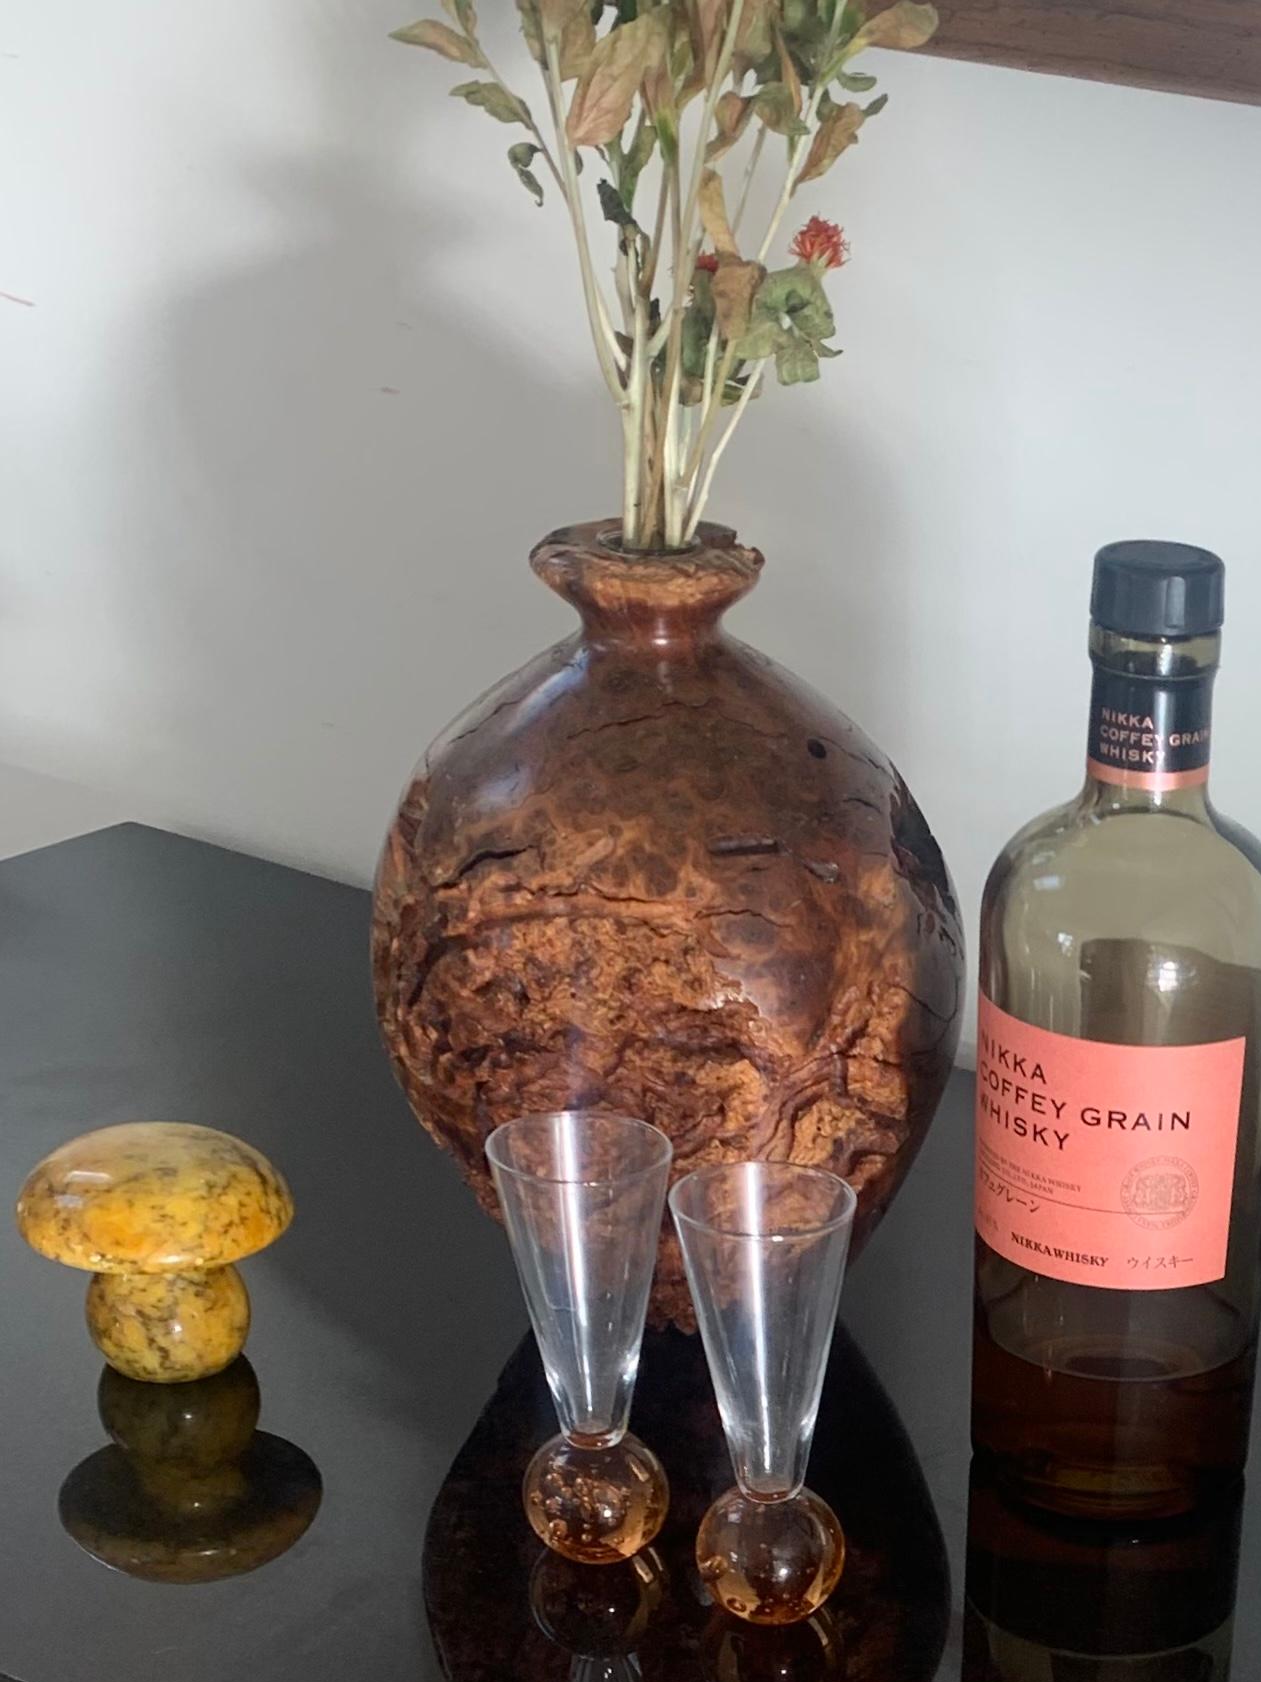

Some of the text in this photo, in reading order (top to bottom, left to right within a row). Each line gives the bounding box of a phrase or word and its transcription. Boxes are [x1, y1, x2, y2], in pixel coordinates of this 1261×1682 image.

[1101, 707, 1154, 729] NIKKA
[1099, 725, 1165, 748] COFFEY
[1099, 742, 1166, 764] WHISKY
[981, 1029, 1047, 1084] NIKKA
[980, 1060, 1191, 1131] COFFEY GRAIN
[979, 1093, 1070, 1151] WHISKY
[1127, 1255, 1194, 1269] ウイスキー
